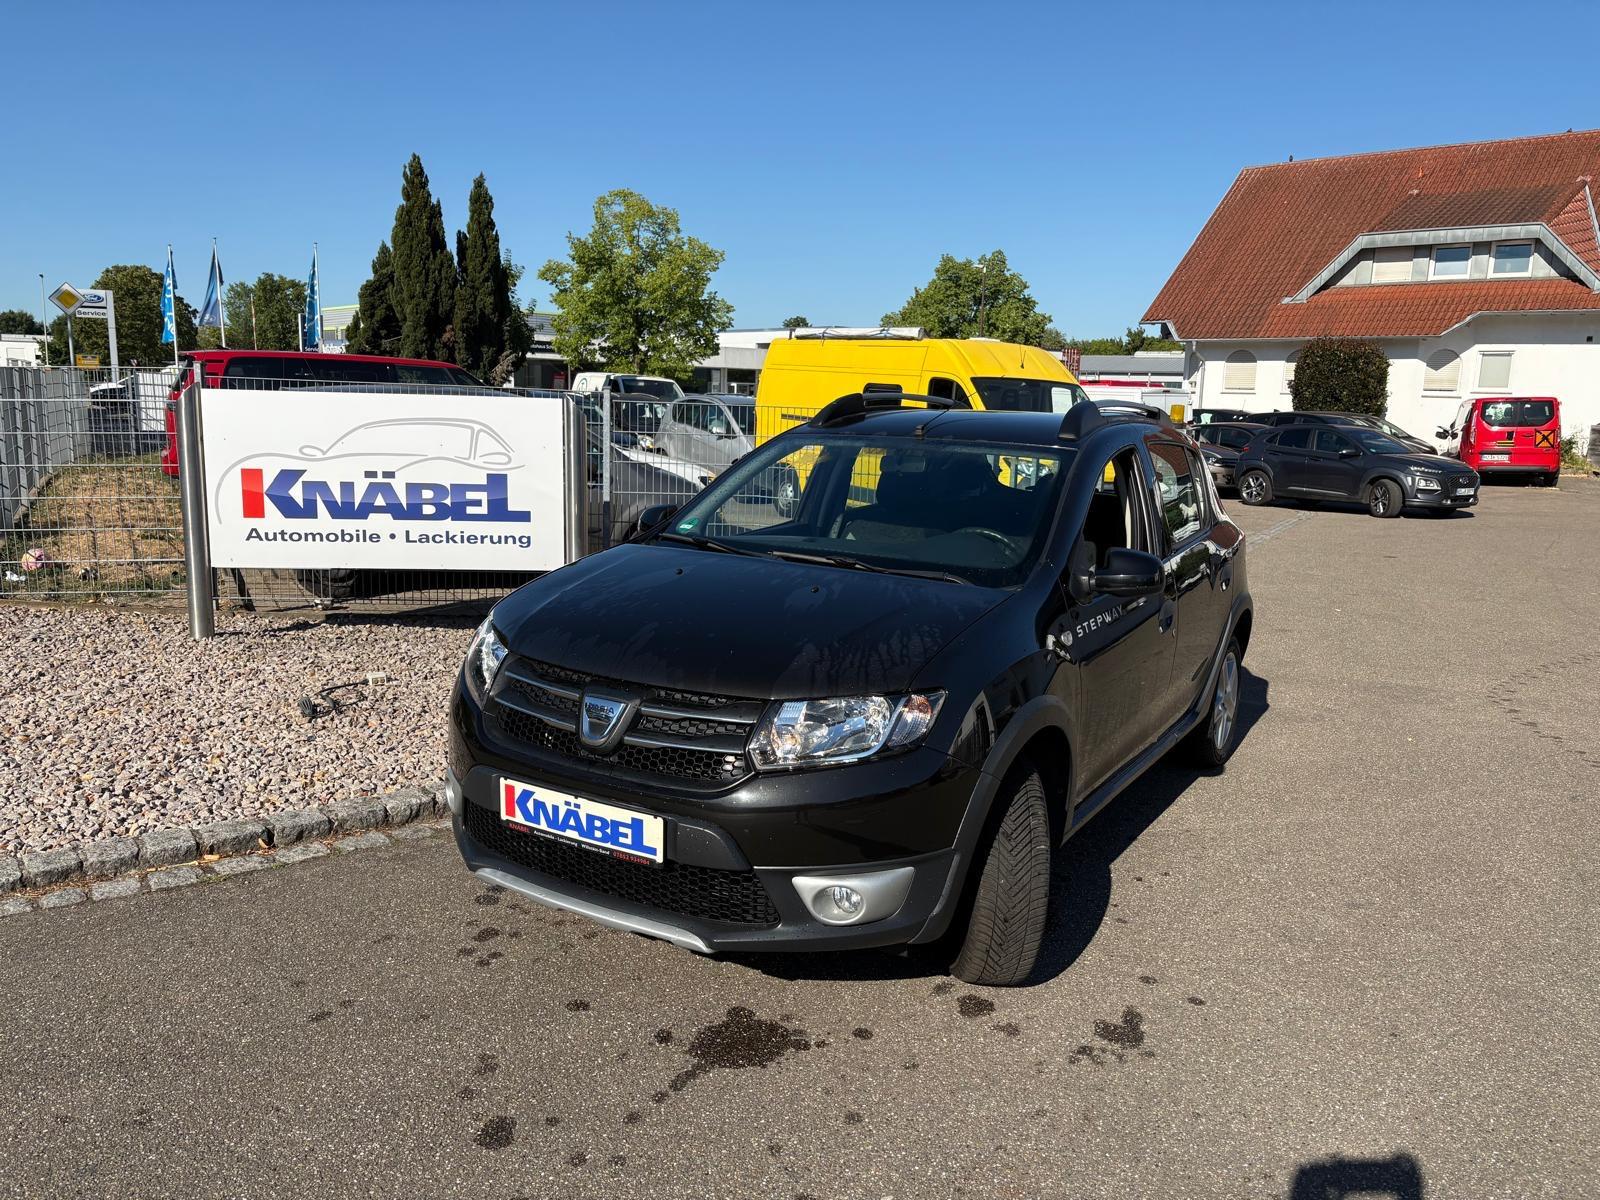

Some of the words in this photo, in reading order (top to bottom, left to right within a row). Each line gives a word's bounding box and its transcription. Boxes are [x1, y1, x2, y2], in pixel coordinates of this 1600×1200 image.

[241, 468, 531, 523] KNÄBEL
[245, 527, 381, 544] Automobile
[405, 530, 532, 549] Lackierung
[1076, 604, 1122, 638] STEPWAY
[505, 784, 657, 856] KNÄBEL
